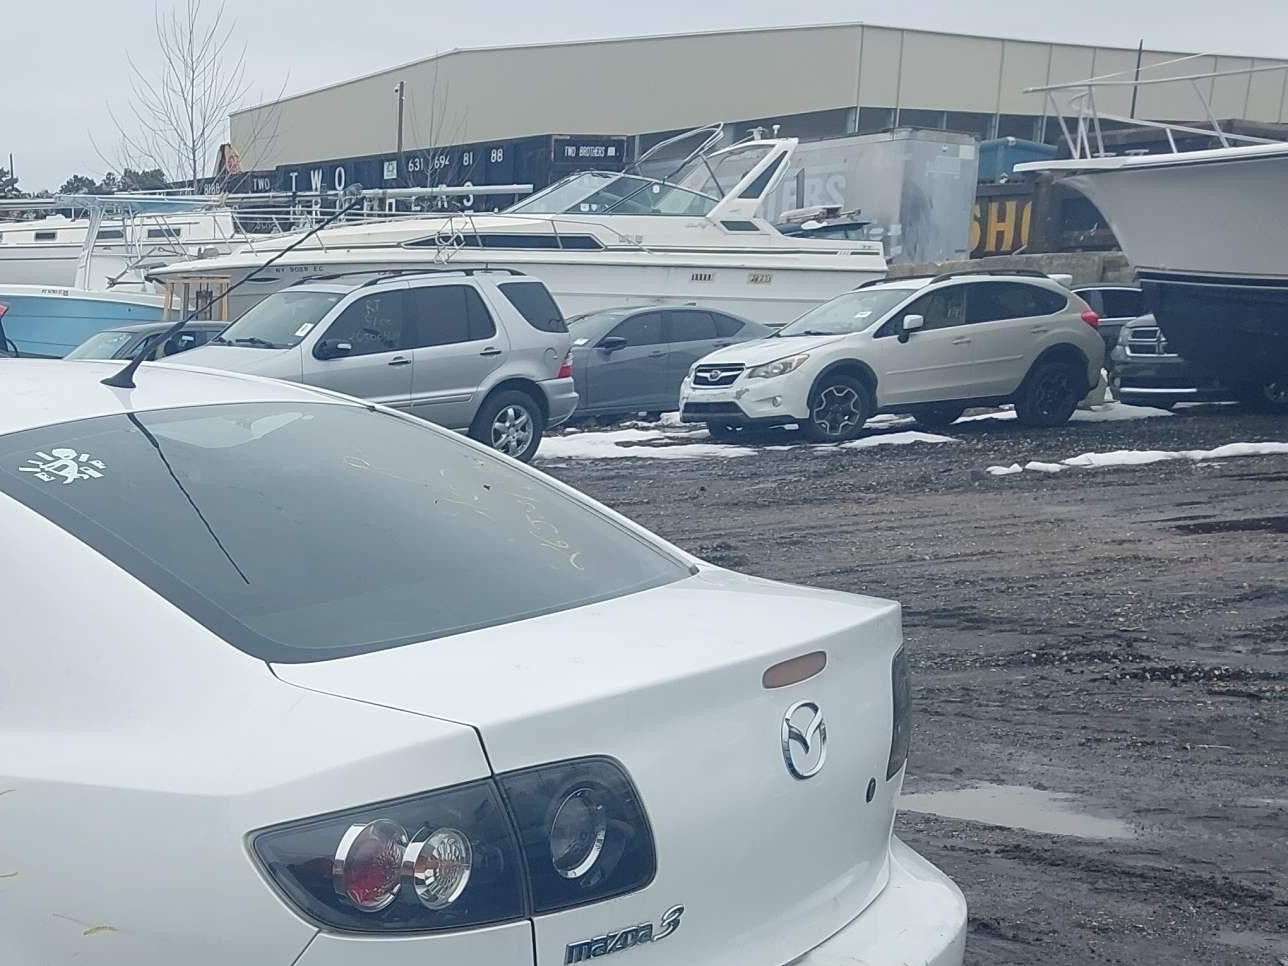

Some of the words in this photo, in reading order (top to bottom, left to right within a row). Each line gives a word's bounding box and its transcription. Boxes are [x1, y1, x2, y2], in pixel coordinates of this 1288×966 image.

[408, 158, 424, 172] 631
[434, 155, 450, 169] 694
[463, 152, 473, 166] 81
[490, 148, 503, 163] 88
[564, 146, 576, 157] TWO
[579, 146, 605, 157] BROTHERS
[253, 178, 270, 191] TWO
[289, 166, 346, 193] TWO
